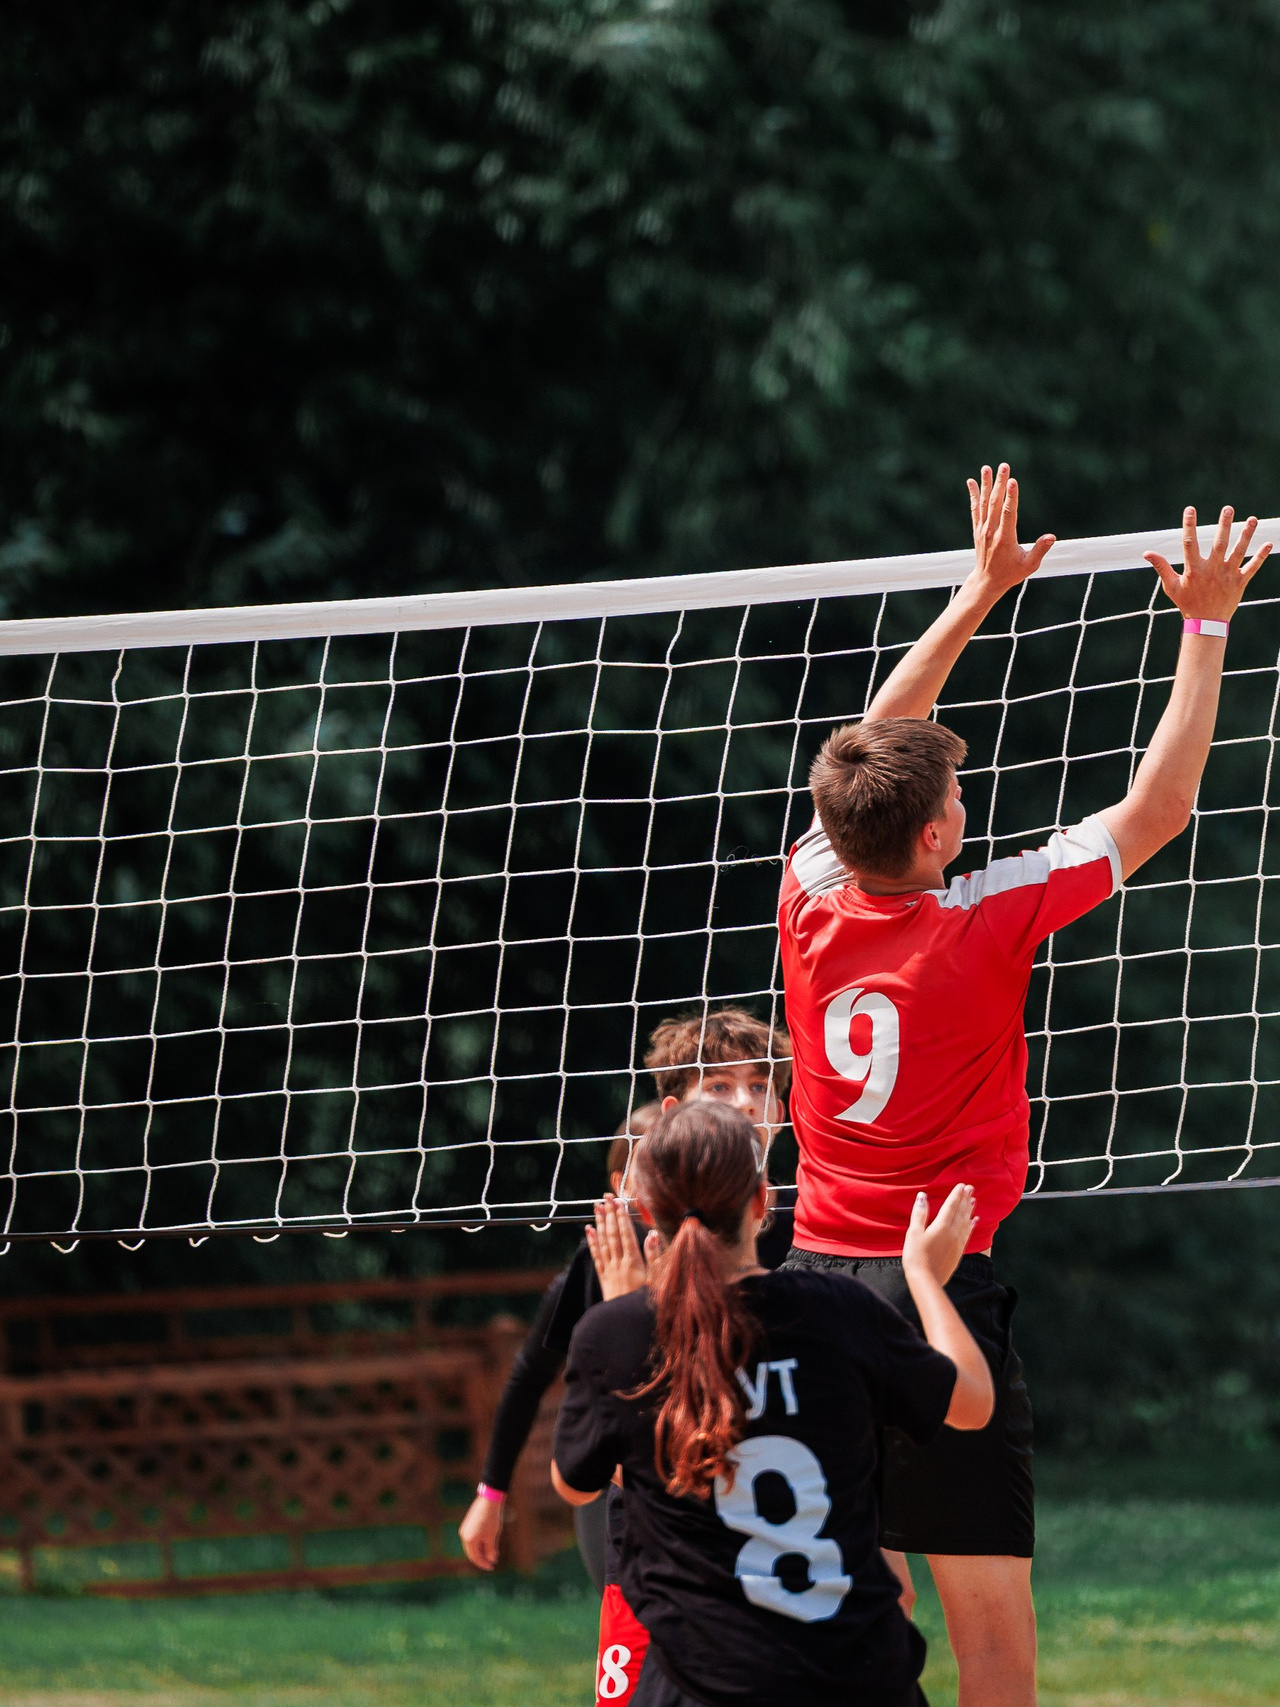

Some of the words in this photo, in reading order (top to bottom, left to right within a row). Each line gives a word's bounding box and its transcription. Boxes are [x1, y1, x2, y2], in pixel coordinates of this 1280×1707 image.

[823, 987, 900, 1124] 9
[714, 1434, 853, 1623] 8
[599, 1644, 631, 1698] 8
